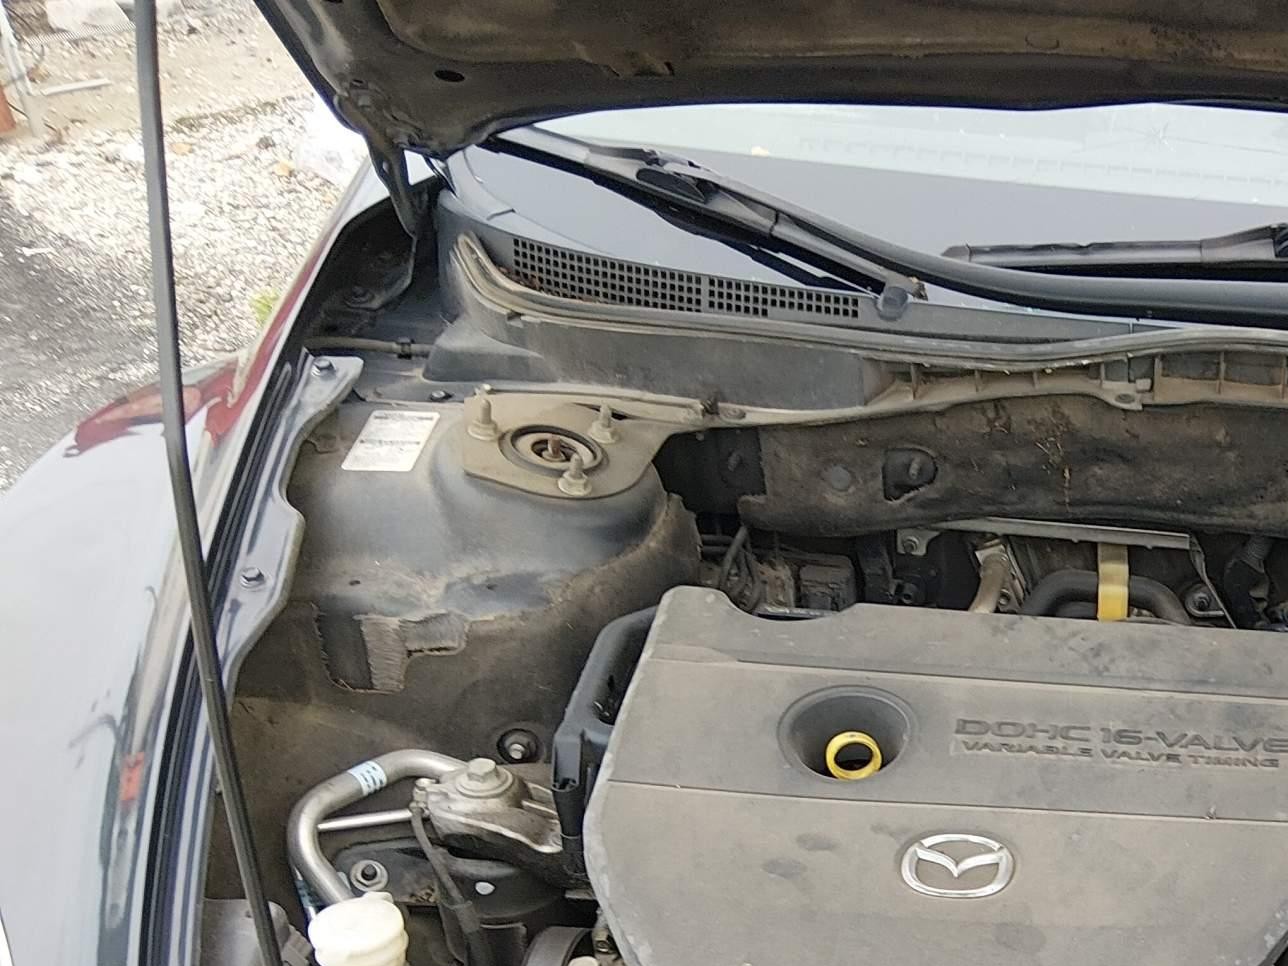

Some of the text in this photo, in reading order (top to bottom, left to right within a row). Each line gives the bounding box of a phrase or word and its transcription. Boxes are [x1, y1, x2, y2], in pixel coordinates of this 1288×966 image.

[954, 717, 1092, 741] DOHC
[961, 739, 1280, 768] VARIABLE VALVE TIMING
